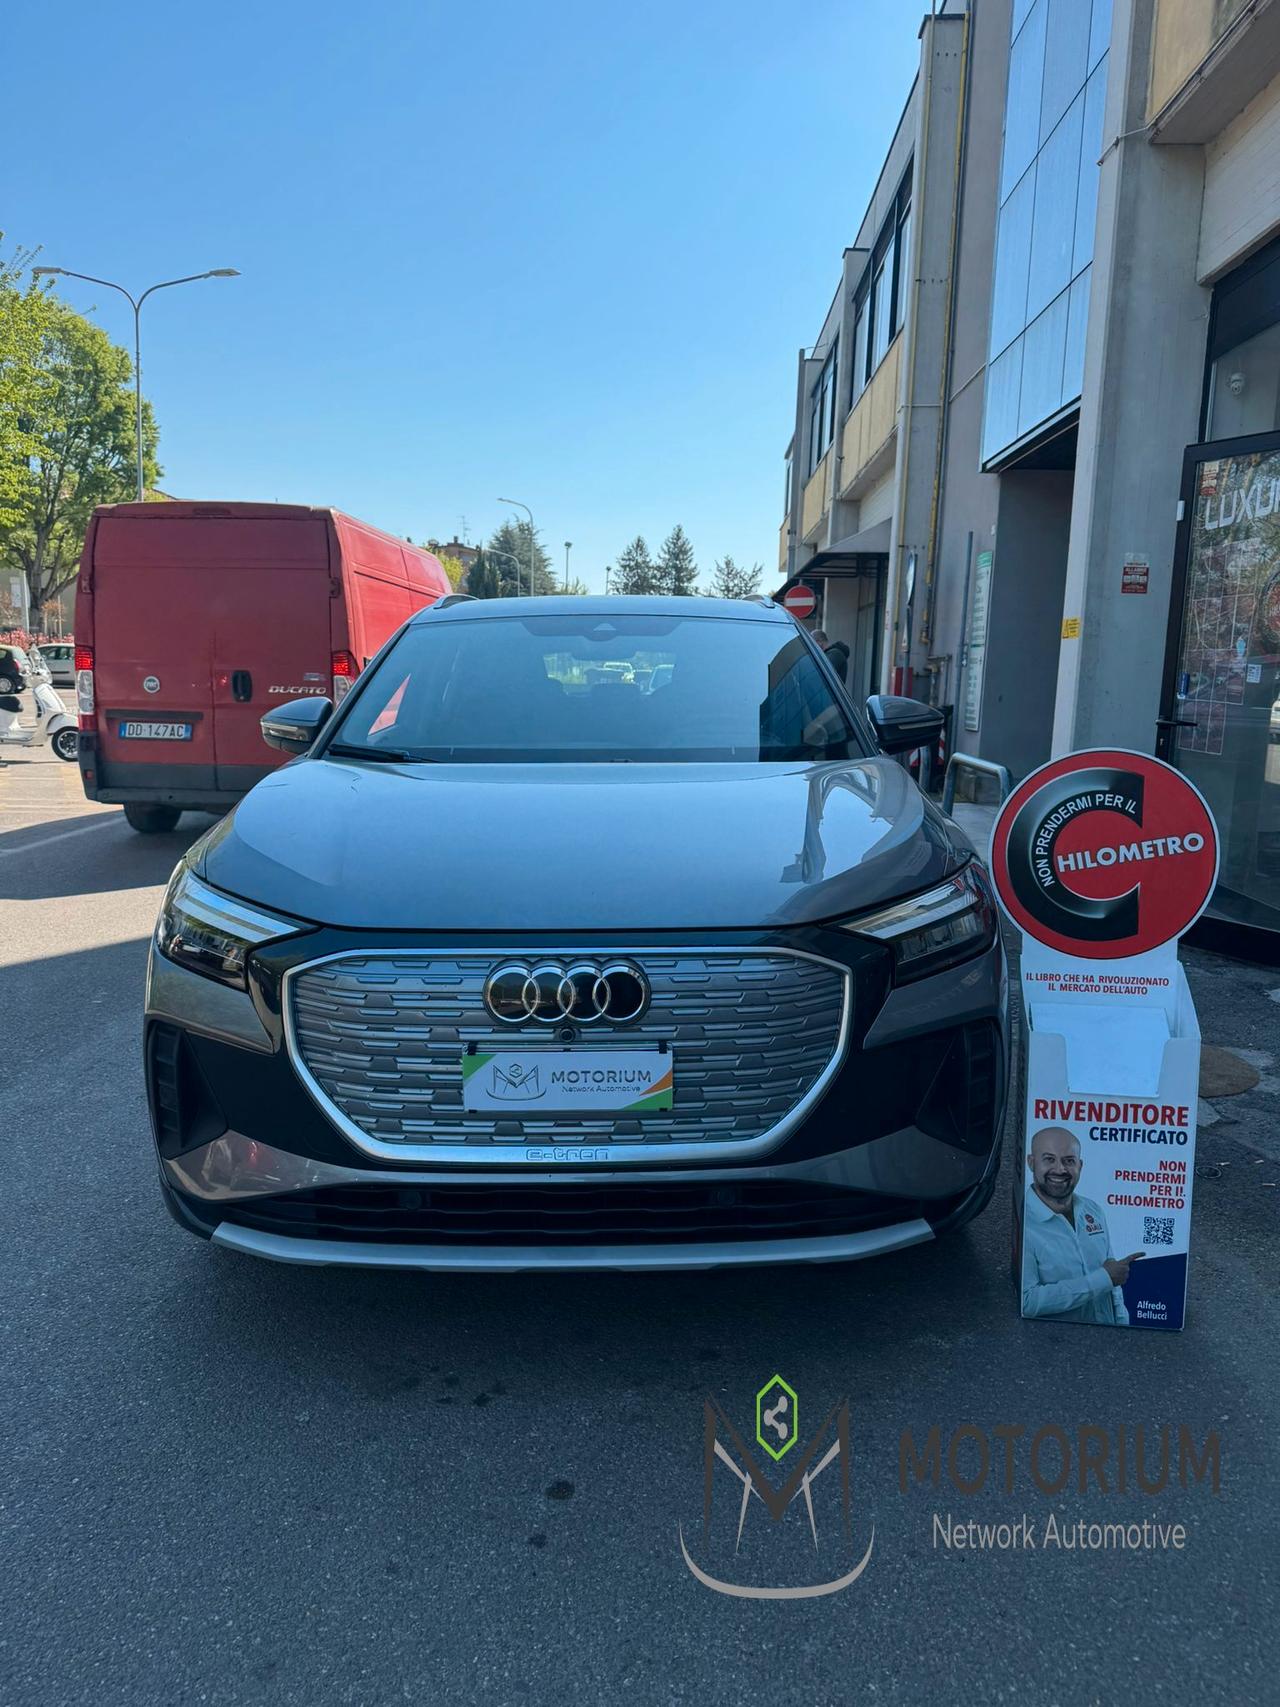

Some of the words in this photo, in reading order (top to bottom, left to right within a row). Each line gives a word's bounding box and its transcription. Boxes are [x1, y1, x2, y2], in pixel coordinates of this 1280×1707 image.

[268, 685, 326, 694] DUCATO
[127, 724, 142, 737] DD
[147, 724, 184, 738] 147AC
[1095, 793, 1124, 808] PER
[1125, 799, 1137, 814] IL
[1036, 795, 1092, 855] PRENDERMI
[1057, 833, 1204, 872] HILOMETRO
[1036, 859, 1055, 887] NON
[1026, 972, 1034, 981] IL
[1035, 973, 1061, 982] LIBRO
[1063, 973, 1080, 983] CHE
[1082, 974, 1095, 983] HA
[1098, 975, 1170, 987] RIVOLUZIONATO
[1048, 982, 1056, 991] IL
[1059, 983, 1100, 993] MERCATO
[1102, 985, 1148, 995] DELL'AUTO
[551, 1070, 652, 1084] MOTORIUM
[562, 1085, 594, 1093] Network
[1034, 1099, 1190, 1127] RIVENDITORE
[1089, 1126, 1188, 1146] CERTIFICATO
[525, 1147, 609, 1161] e-tron
[1159, 1160, 1187, 1172] NON
[1114, 1170, 1186, 1185] PRENDERMI
[1149, 1185, 1172, 1197] PER
[1107, 1194, 1185, 1209] CHILOMETRO
[1137, 1300, 1166, 1310] Alfredo
[1137, 1310, 1167, 1320] Bellucci
